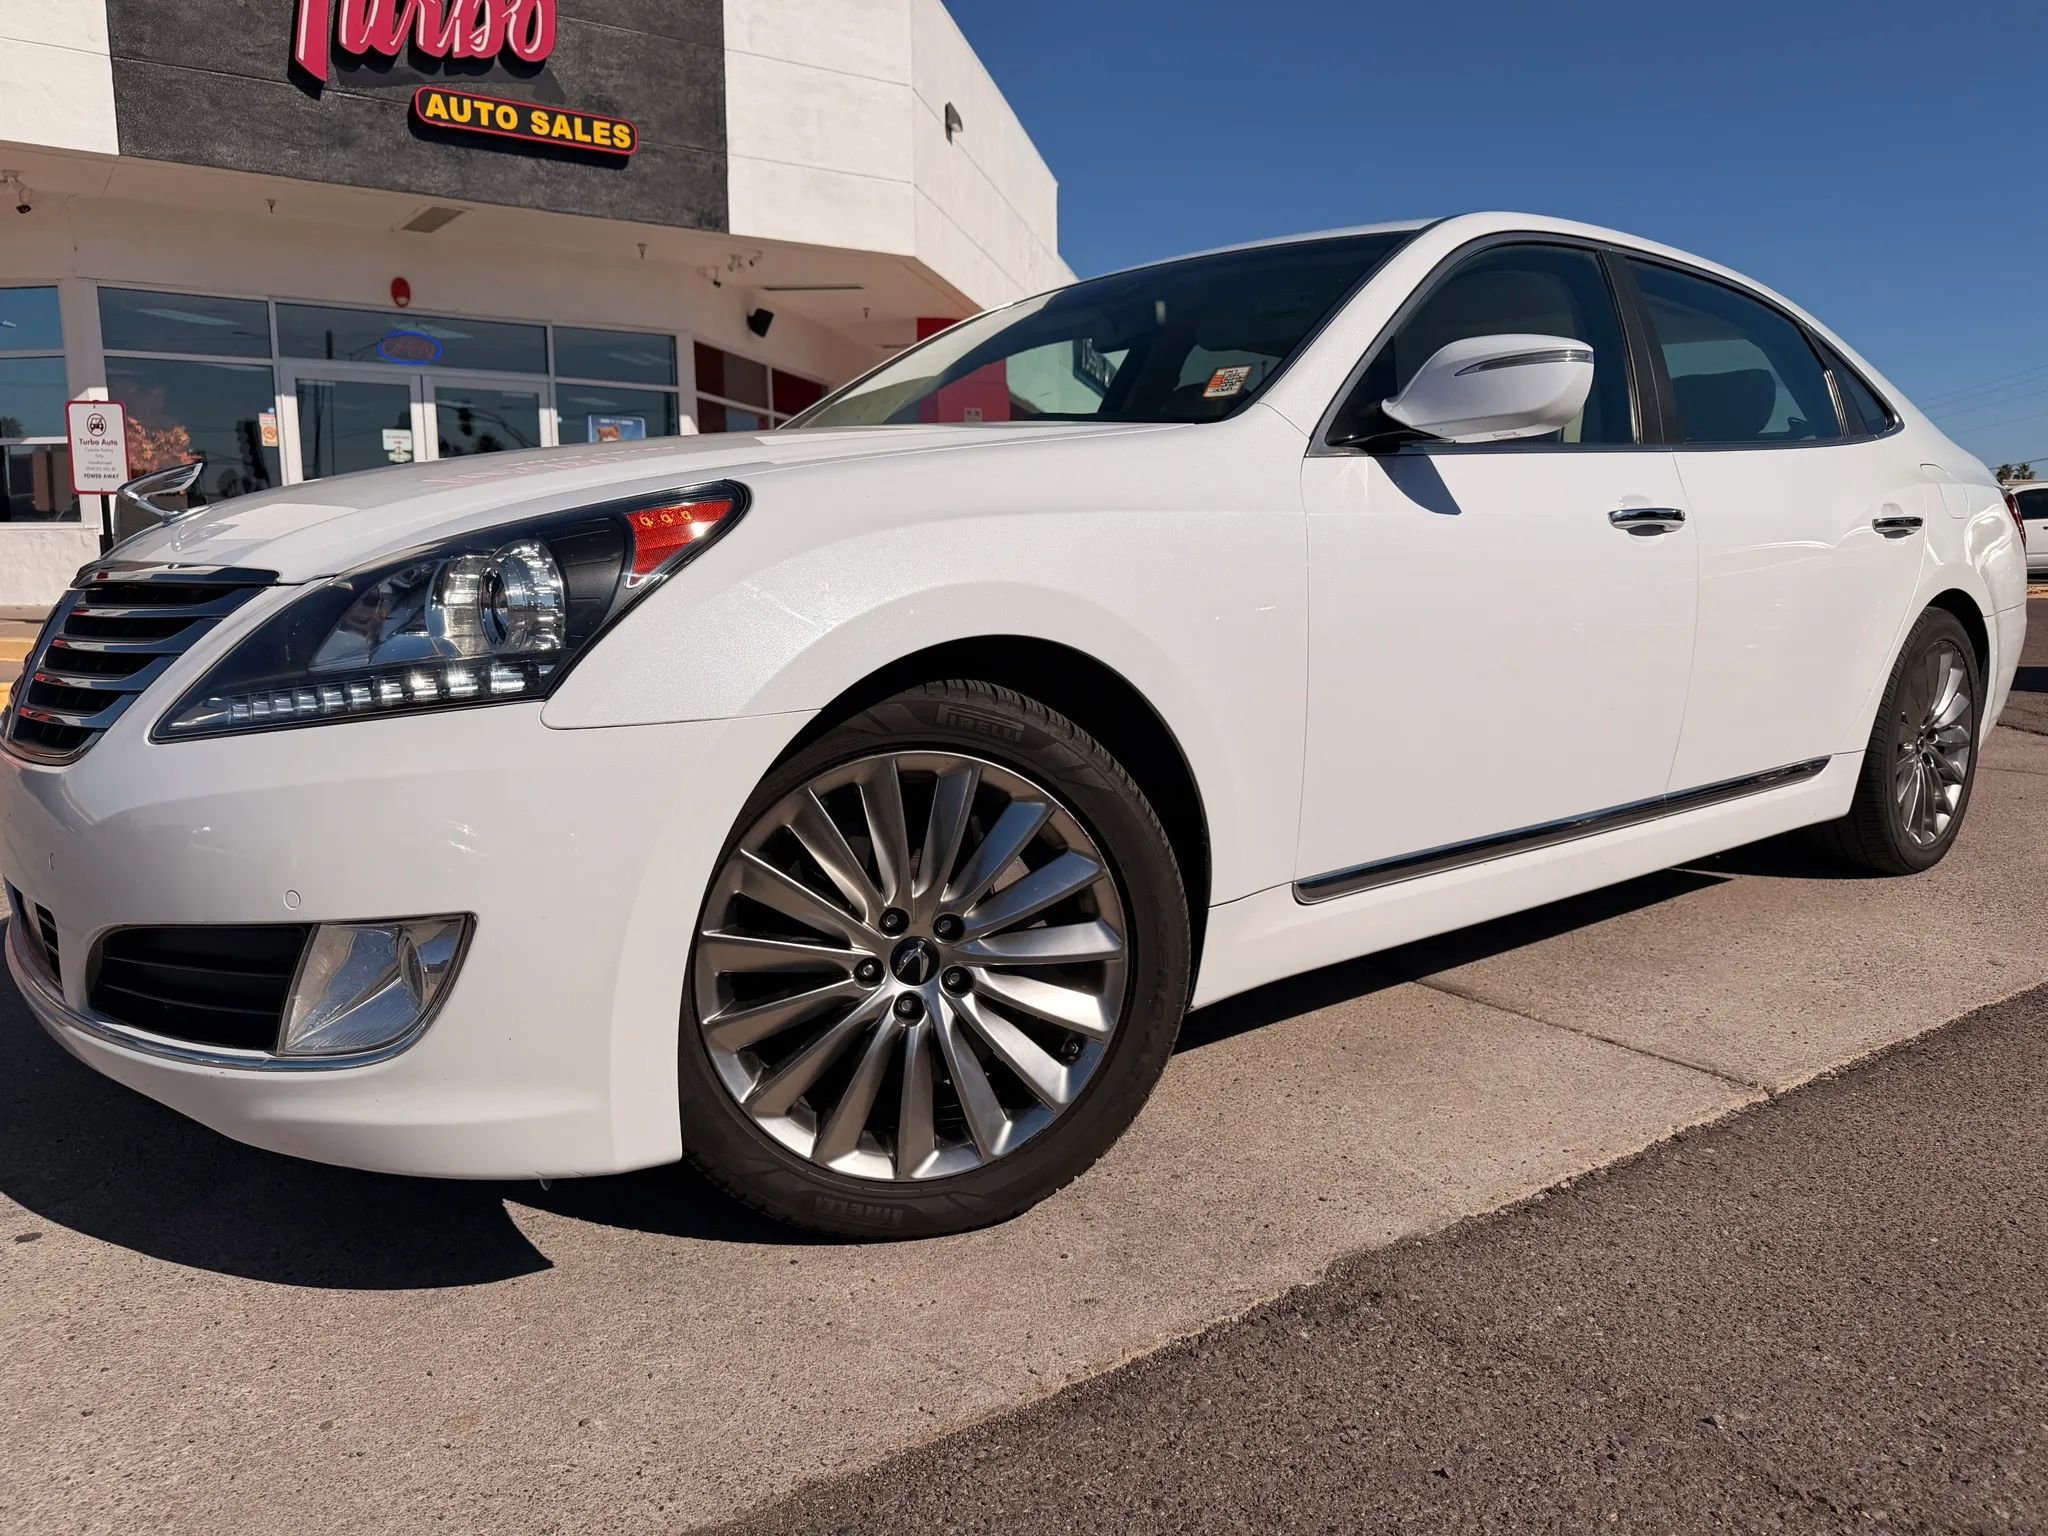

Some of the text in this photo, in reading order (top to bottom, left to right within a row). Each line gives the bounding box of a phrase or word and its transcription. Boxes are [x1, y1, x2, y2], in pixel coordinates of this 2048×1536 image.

[425, 94, 632, 148] AUTO SALES
[79, 438, 118, 446] Turbo Auto
[935, 703, 1025, 743] PIRELLI
